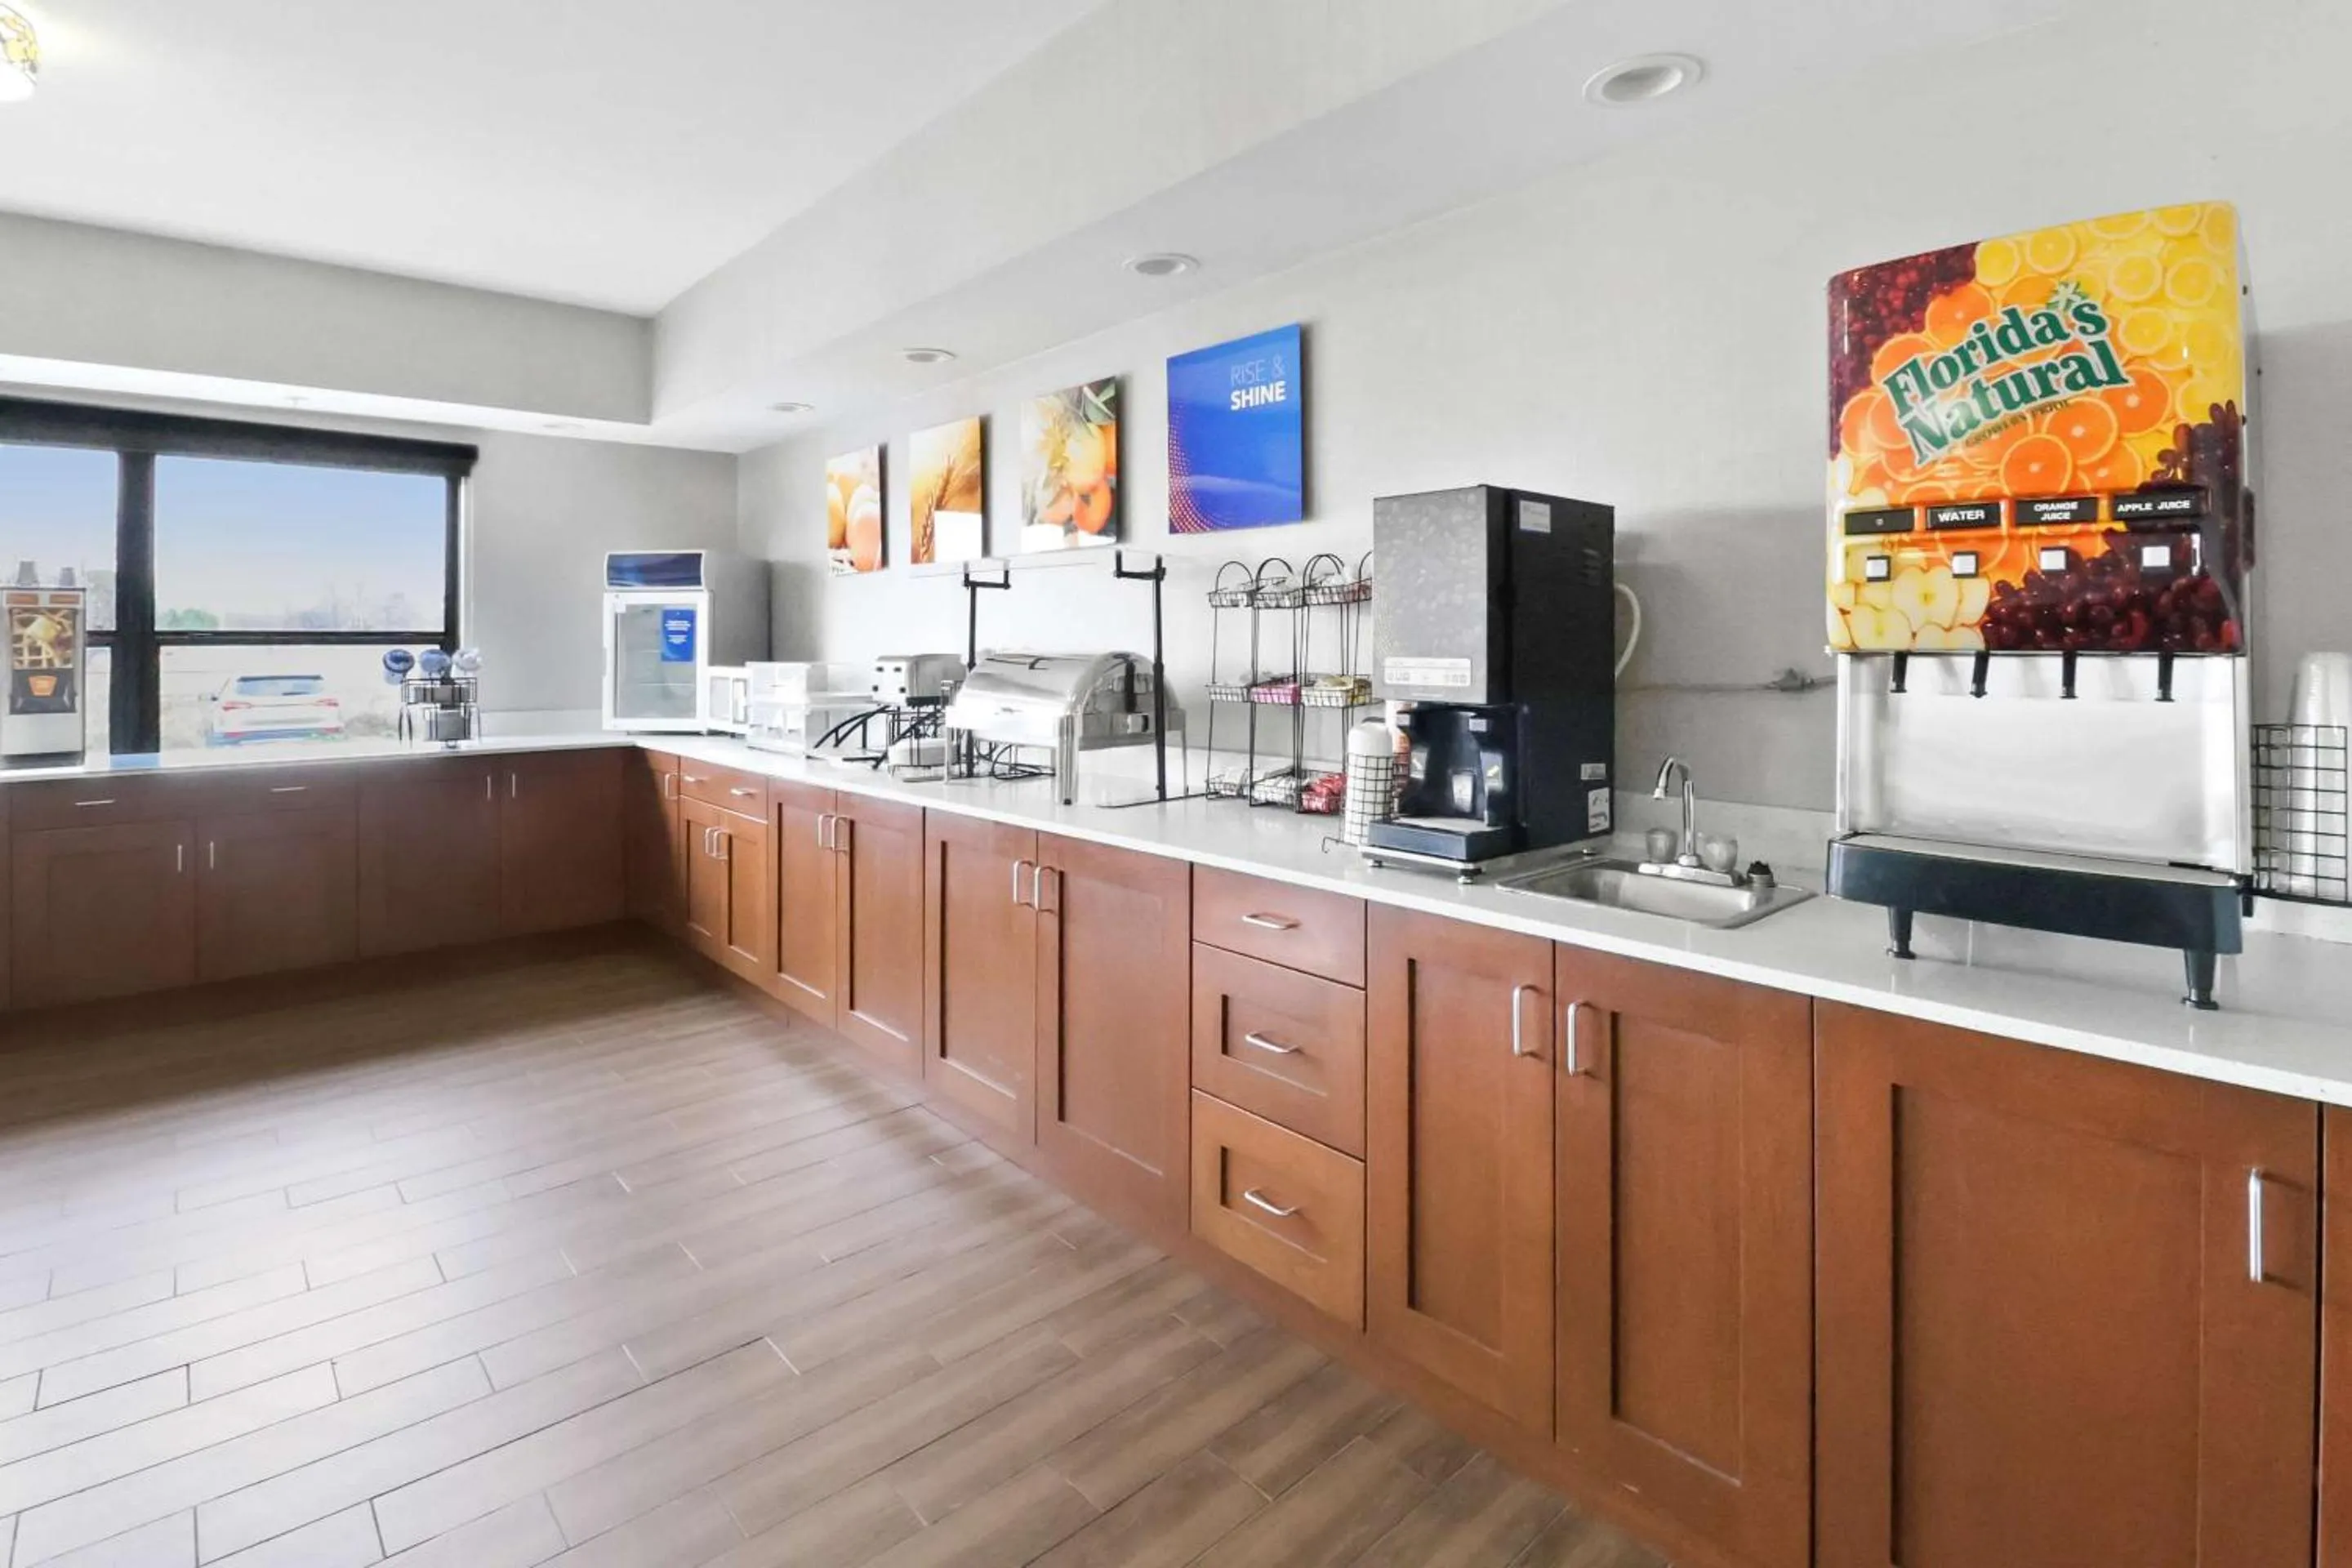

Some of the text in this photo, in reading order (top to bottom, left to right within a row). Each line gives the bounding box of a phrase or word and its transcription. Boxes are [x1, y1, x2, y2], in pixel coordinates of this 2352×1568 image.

[1883, 300, 2108, 416] Florida's
[1231, 355, 1287, 386] RISE &
[1231, 380, 1286, 411] SHINE
[1902, 339, 2129, 466] Natural
[1937, 509, 1985, 523] WATER
[2033, 501, 2078, 512] ORANGE
[2040, 511, 2071, 521] JUICE
[2117, 500, 2191, 513] APPLE JUICE
